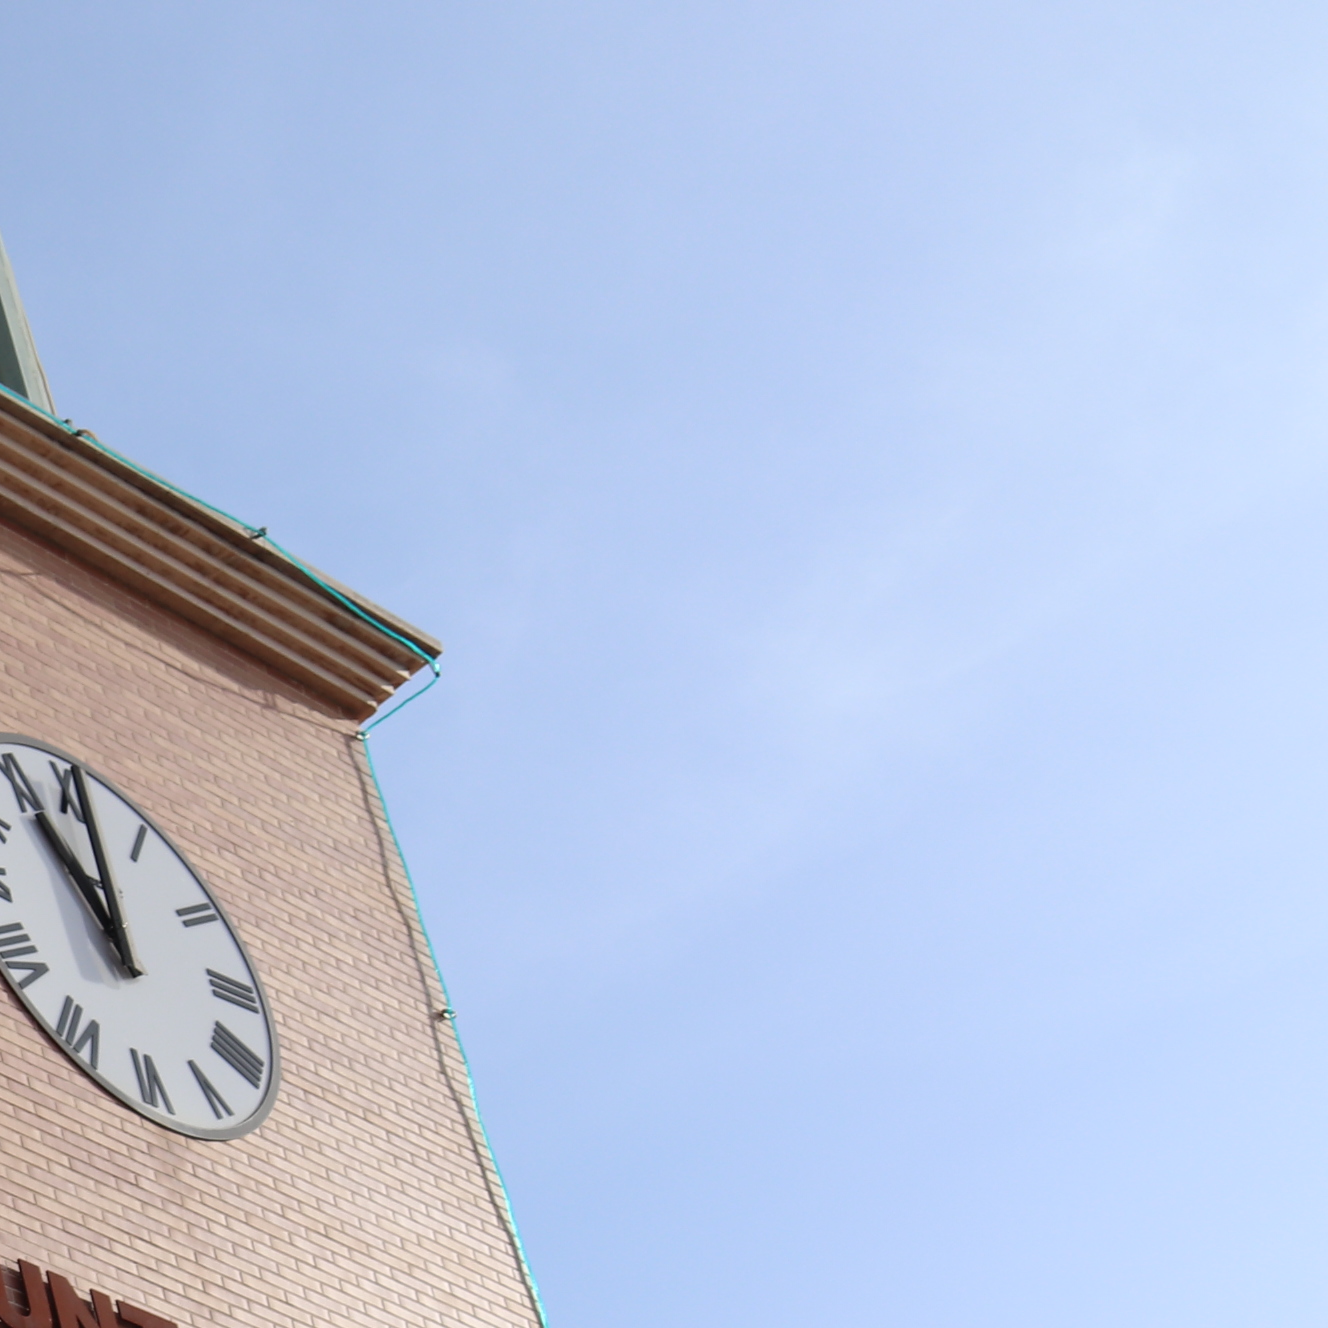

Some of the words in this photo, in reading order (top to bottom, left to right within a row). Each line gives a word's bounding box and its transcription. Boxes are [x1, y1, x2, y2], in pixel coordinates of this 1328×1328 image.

[130, 823, 148, 863] I
[175, 902, 220, 928] II
[206, 967, 261, 1015] III
[56, 994, 100, 1071] VII
[130, 1047, 176, 1116] VI
[187, 1058, 234, 1120] V
